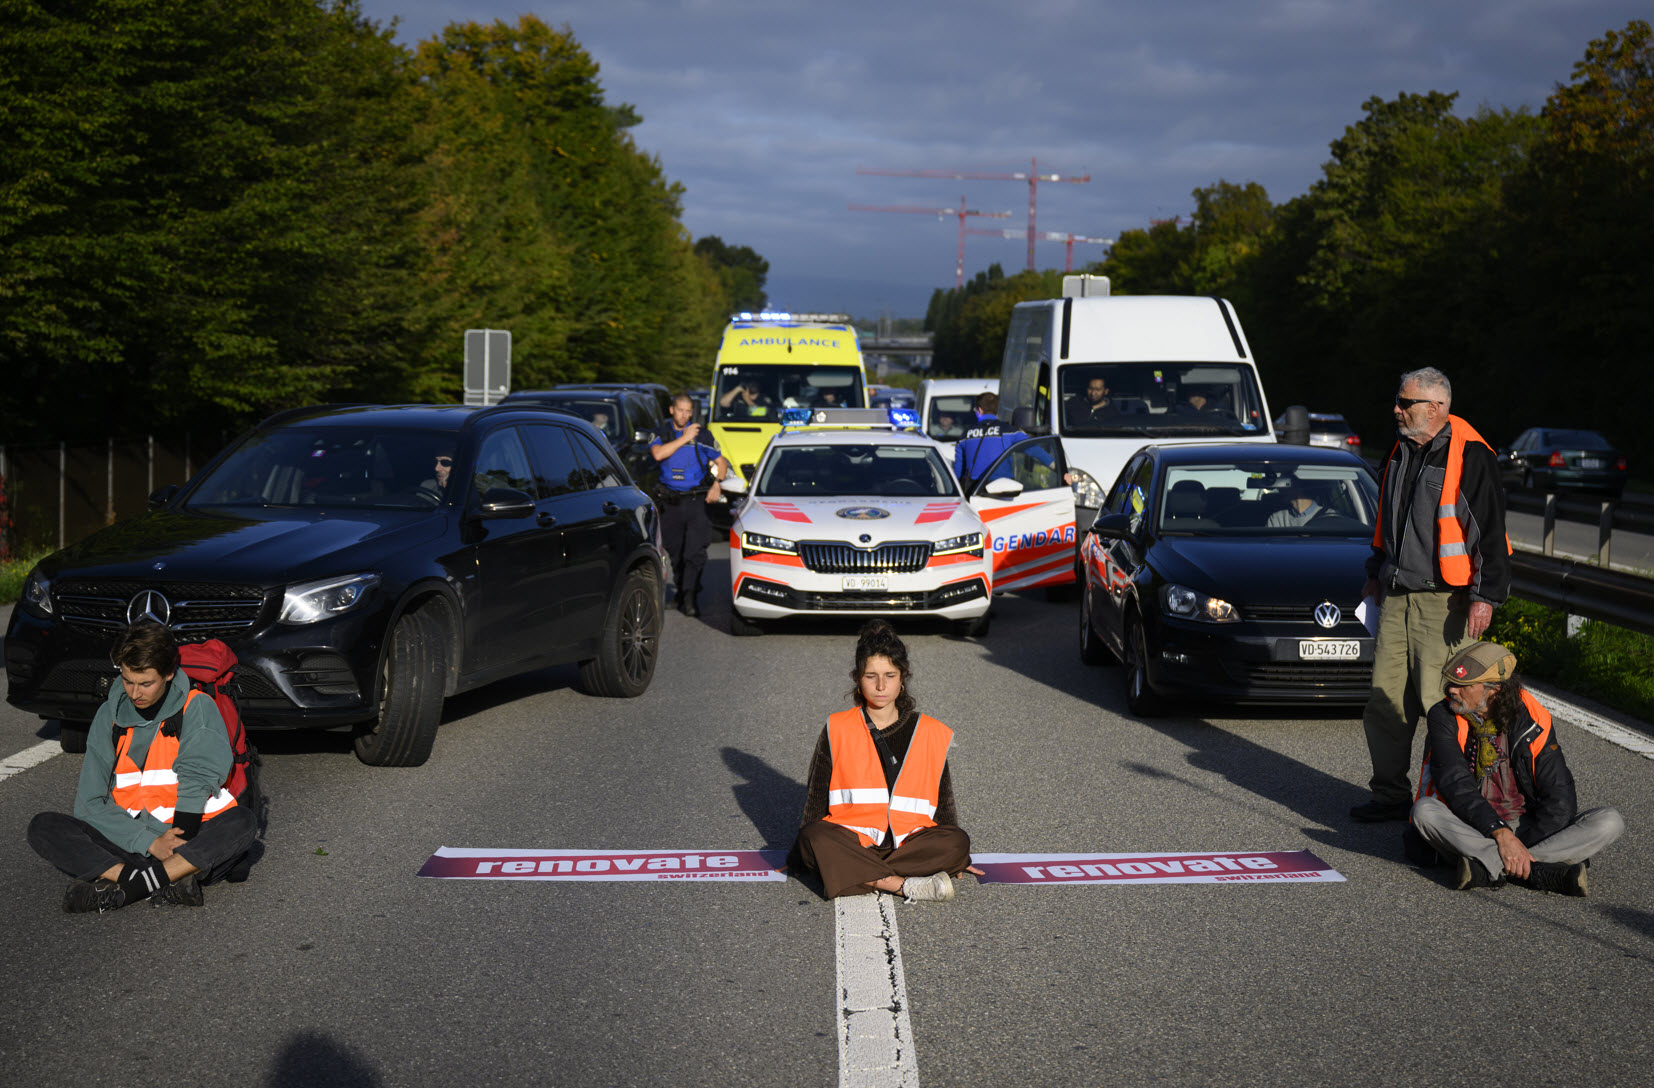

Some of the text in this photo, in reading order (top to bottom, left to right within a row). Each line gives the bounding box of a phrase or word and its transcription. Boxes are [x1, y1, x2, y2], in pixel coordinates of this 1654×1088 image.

[739, 338, 840, 348] AMBULANCE
[993, 527, 1075, 552] GENDAR
[475, 854, 740, 874] renovate
[1022, 856, 1278, 878] renovate
[657, 871, 769, 879] switzerland
[1214, 871, 1321, 882] switzerland
